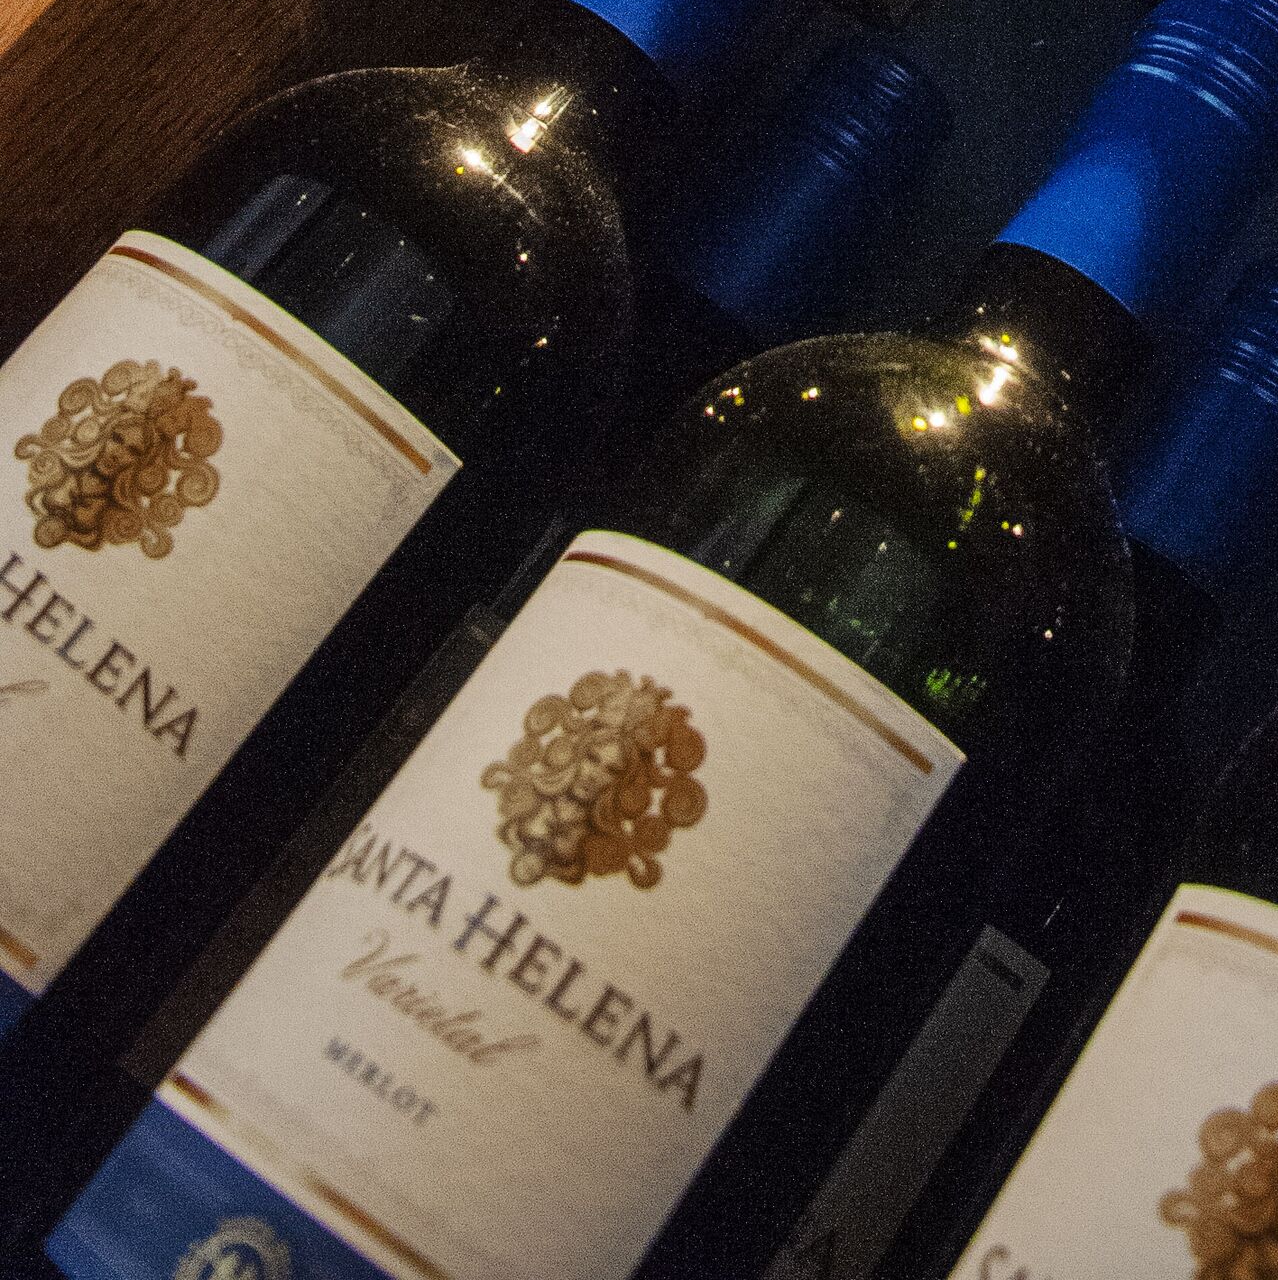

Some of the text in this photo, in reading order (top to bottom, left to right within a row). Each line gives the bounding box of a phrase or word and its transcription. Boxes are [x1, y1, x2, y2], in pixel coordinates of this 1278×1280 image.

[0, 551, 203, 762] HELENA
[327, 823, 705, 1113] ANTA HELENA
[320, 1036, 444, 1129] MERLOT
